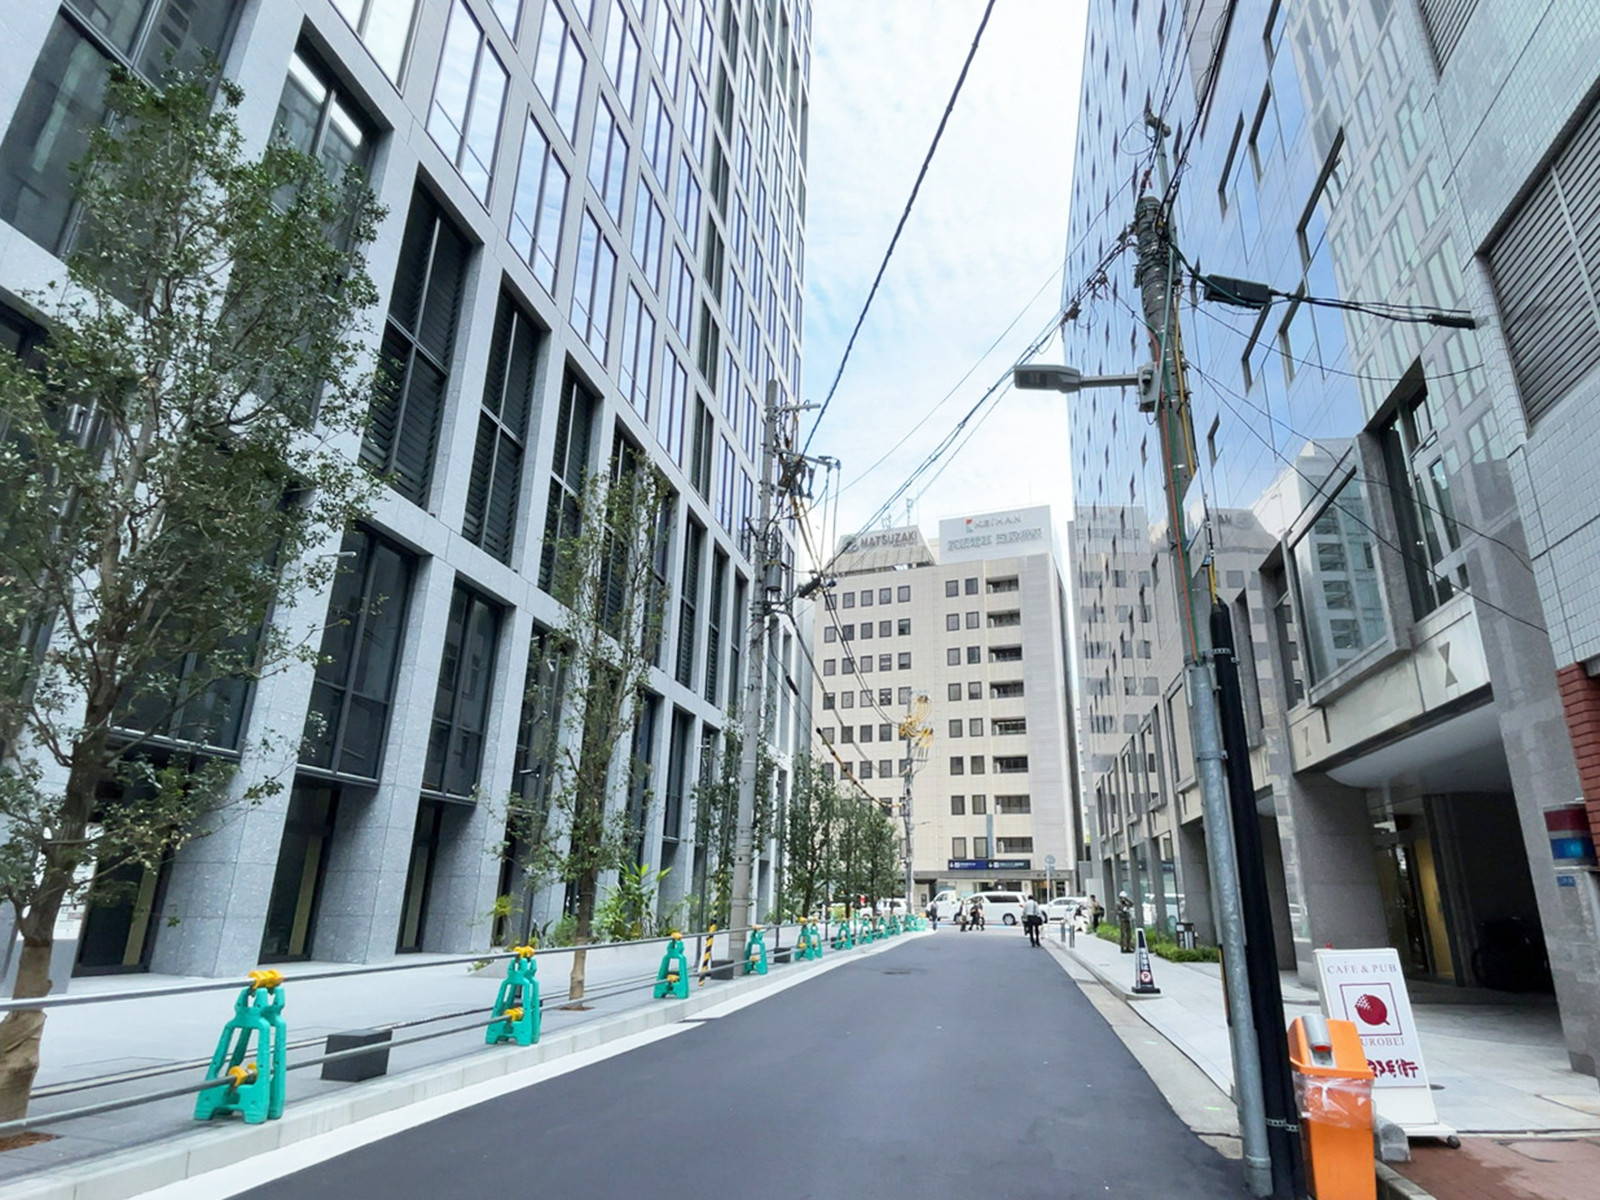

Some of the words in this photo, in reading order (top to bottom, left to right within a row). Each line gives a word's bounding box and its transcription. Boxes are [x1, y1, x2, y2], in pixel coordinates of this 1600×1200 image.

[860, 530, 918, 548] MATSUZAKI
[1360, 964, 1370, 974] &
[1371, 963, 1398, 973] PUB
[1360, 1037, 1405, 1047] UROBEI
